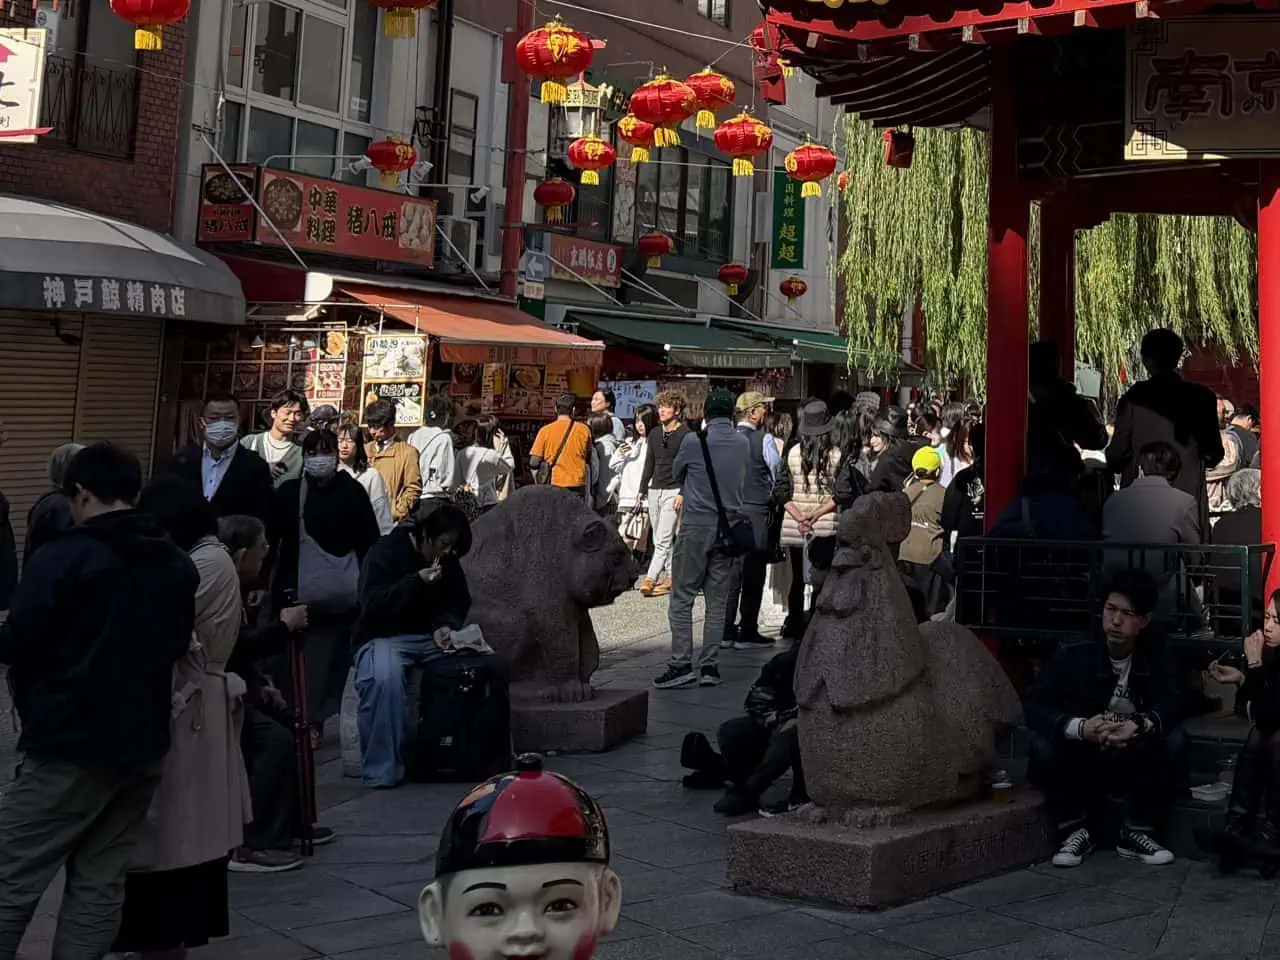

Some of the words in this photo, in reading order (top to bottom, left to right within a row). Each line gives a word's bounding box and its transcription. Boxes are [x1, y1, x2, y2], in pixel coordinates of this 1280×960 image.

[308, 185, 338, 216] 中華
[784, 175, 795, 217] 国料理
[307, 215, 337, 244] 料理
[347, 204, 398, 240] 猪八戒
